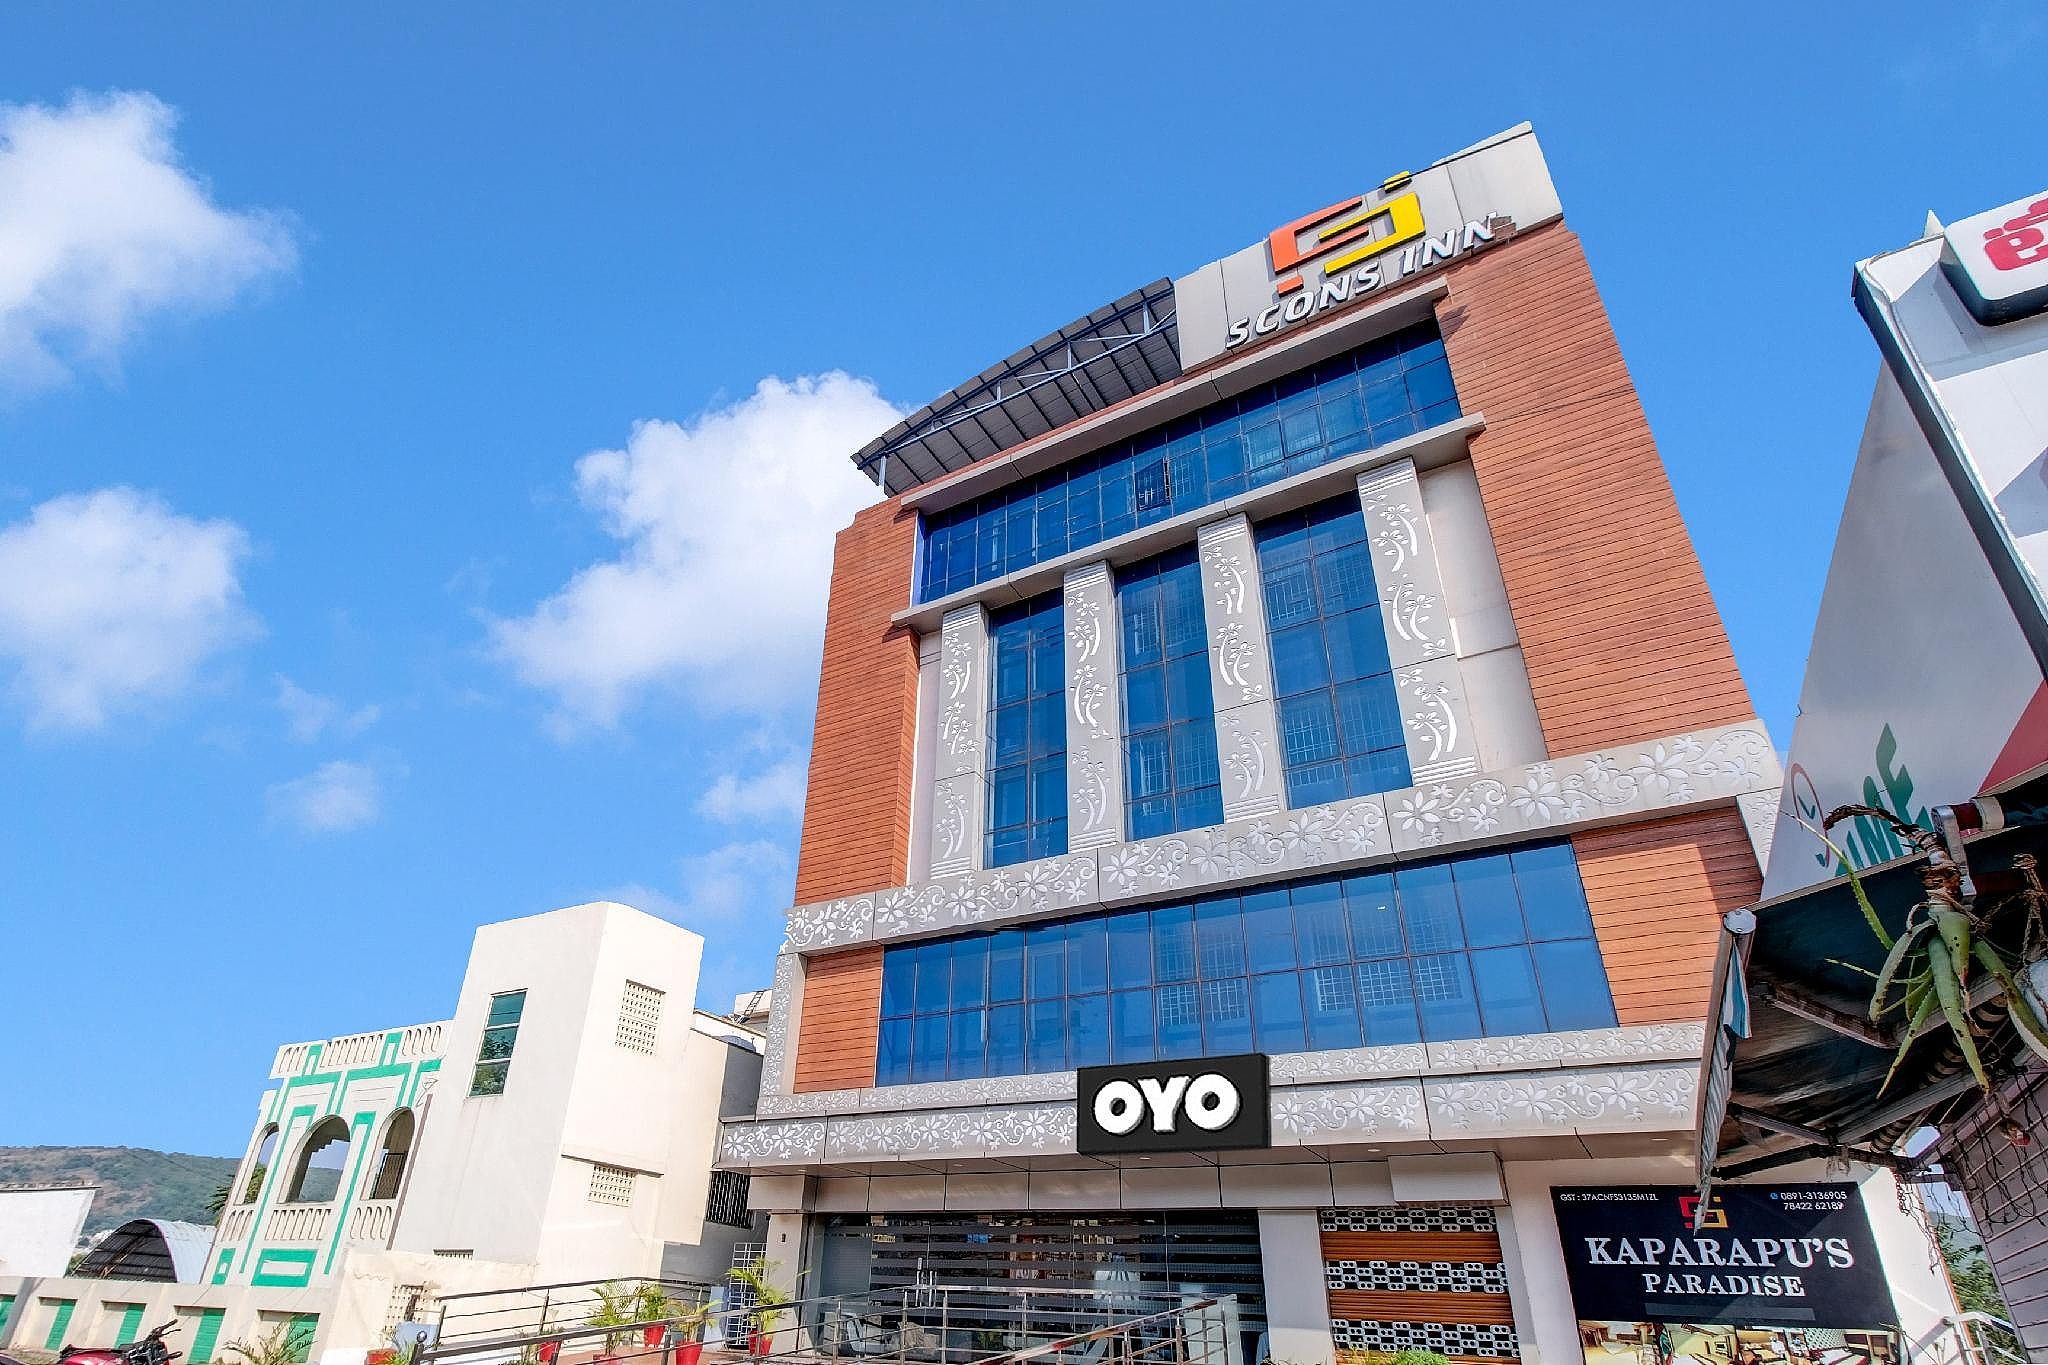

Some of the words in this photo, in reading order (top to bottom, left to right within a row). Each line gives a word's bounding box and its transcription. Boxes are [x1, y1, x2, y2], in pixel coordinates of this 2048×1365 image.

[1225, 261, 1380, 350] SCONS
[1402, 211, 1497, 276] INN
[1093, 1072, 1242, 1135] OYO
[1780, 1191, 1847, 1200] 0891-3136905
[1783, 1202, 1812, 1210] 78422
[1815, 1202, 1844, 1210] 62189
[1584, 1237, 1855, 1269] KAPARAPU'S
[1642, 1273, 1806, 1297] PARADISE
